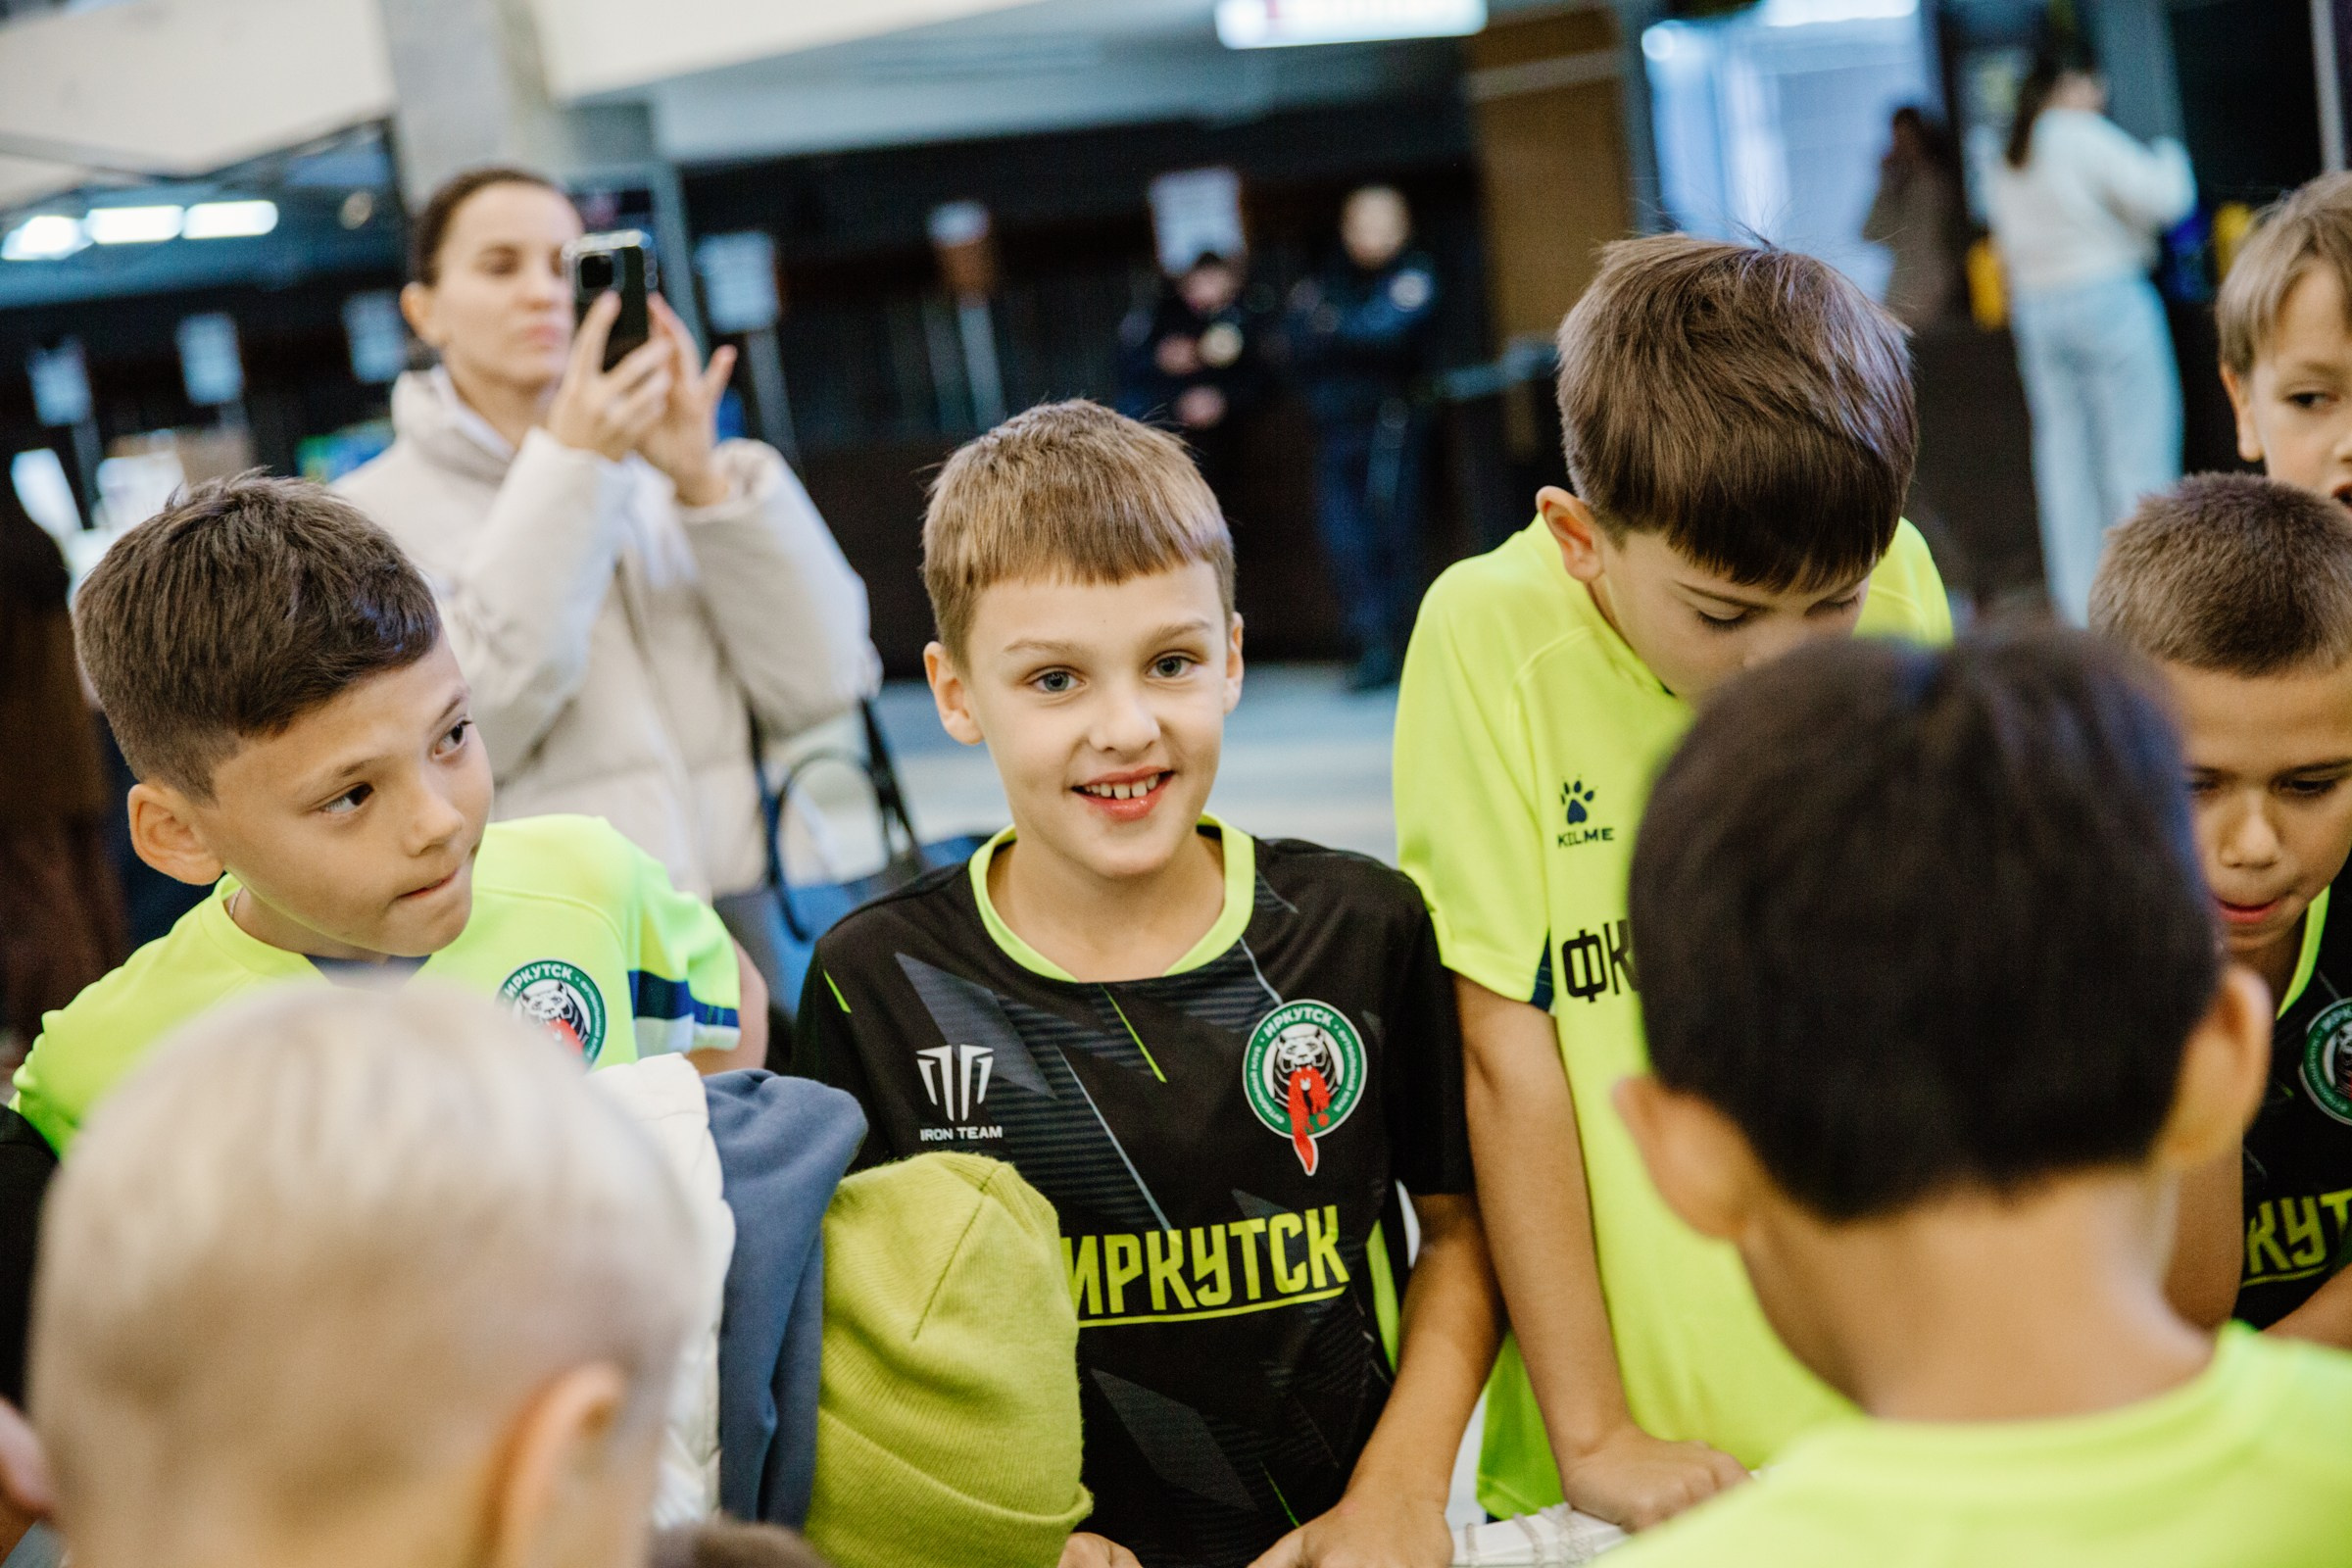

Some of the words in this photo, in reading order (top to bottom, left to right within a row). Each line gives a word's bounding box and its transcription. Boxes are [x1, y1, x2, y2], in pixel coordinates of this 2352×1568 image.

[1557, 828, 1615, 848] KILME
[504, 963, 573, 998] ИРКУТСК
[1262, 1006, 1334, 1039] ИРКУТСК
[919, 1127, 955, 1142] IRON
[956, 1125, 1003, 1140] TEAM
[1060, 1204, 1350, 1315] ИРКУТСК
